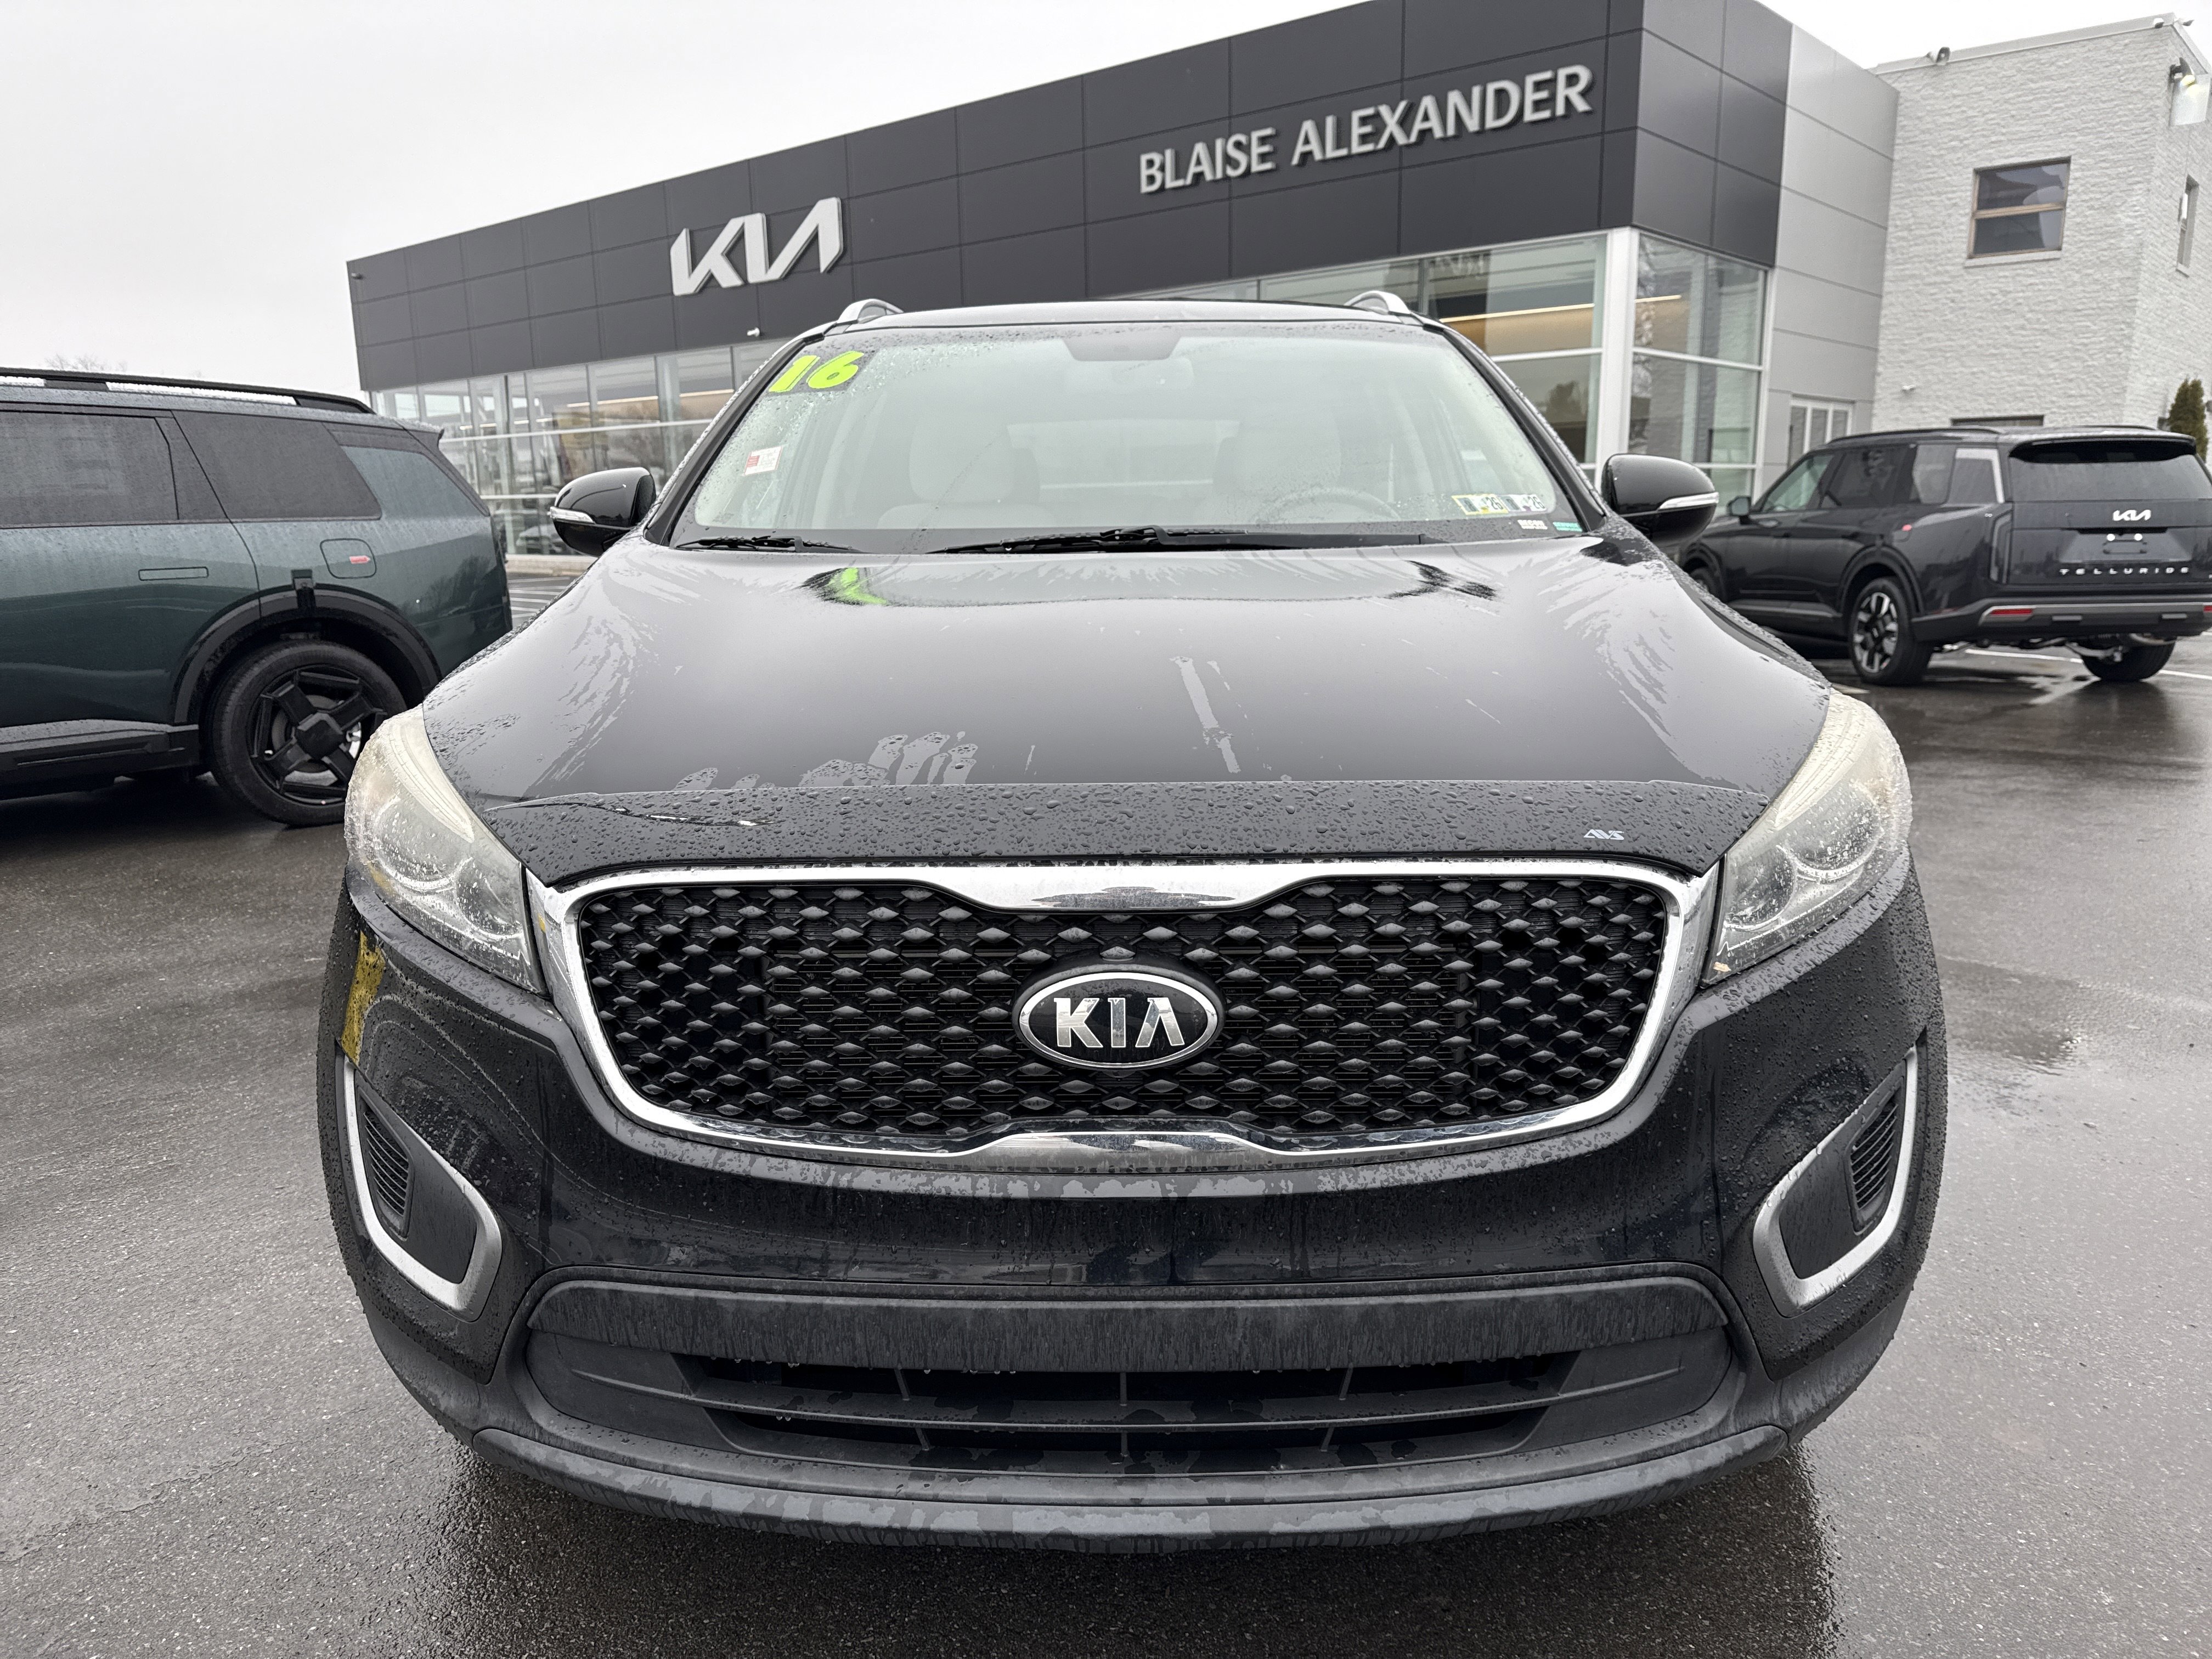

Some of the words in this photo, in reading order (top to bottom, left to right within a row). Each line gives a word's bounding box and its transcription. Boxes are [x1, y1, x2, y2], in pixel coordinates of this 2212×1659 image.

[1139, 127, 1276, 194] BLAISE
[1291, 63, 1594, 166] ALEXANDER
[670, 196, 844, 297] KIA
[769, 351, 865, 393] 16
[2059, 567, 2189, 575] TELLURIDE
[1583, 829, 1624, 840] AVS
[1053, 997, 1185, 1048] KIA
